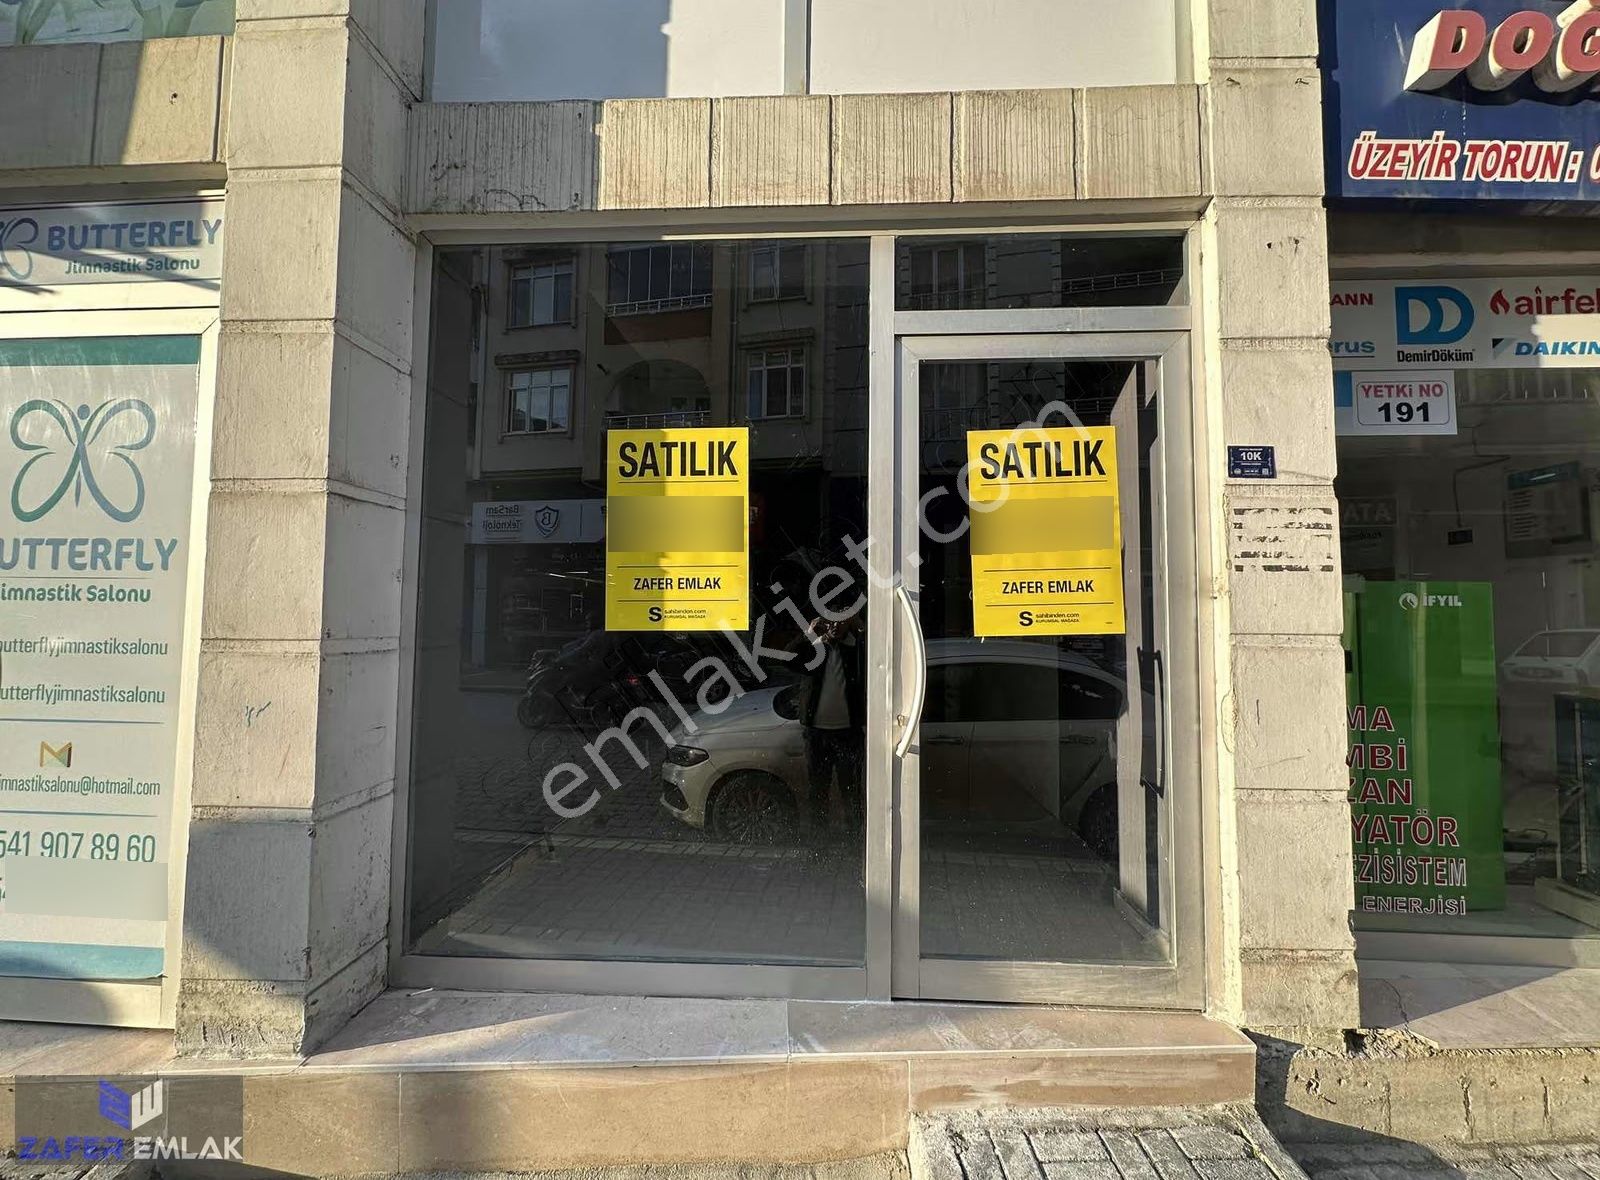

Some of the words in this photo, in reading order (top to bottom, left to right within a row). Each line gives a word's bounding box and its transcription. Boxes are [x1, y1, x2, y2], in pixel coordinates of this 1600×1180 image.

[1349, 131, 1459, 181] ÜZEYİR
[47, 218, 222, 251] BUTTERFLY
[65, 258, 142, 275] Jimnastik
[145, 256, 200, 271] Salonu
[1330, 292, 1373, 306] ANN
[1328, 340, 1375, 353] rus
[1397, 349, 1474, 363] DemirDöküm
[1419, 383, 1444, 397] NO
[1378, 402, 1429, 423] 191
[618, 441, 738, 478] SATILIK
[980, 440, 1106, 480] SATILIK
[1240, 452, 1262, 461] 10K
[0, 538, 178, 571] UTTERFLY
[1, 583, 82, 602] imnastik
[86, 584, 151, 602] Salonu
[634, 578, 673, 590] ZAFER
[678, 577, 721, 590] EMLAK
[1002, 581, 1043, 594] ZAFER
[1048, 580, 1094, 593] EMLAK
[648, 606, 662, 622] S
[1019, 611, 1033, 627] S
[0, 637, 168, 657] utterflyjimnastiksalonu
[0, 684, 165, 705] utterflyjimnastiksalonu
[1351, 808, 1459, 847] YATÖR
[41, 831, 84, 859] 907
[90, 833, 120, 861] 89
[127, 834, 156, 863] 60
[1363, 895, 1466, 915] ENERJİSİ
